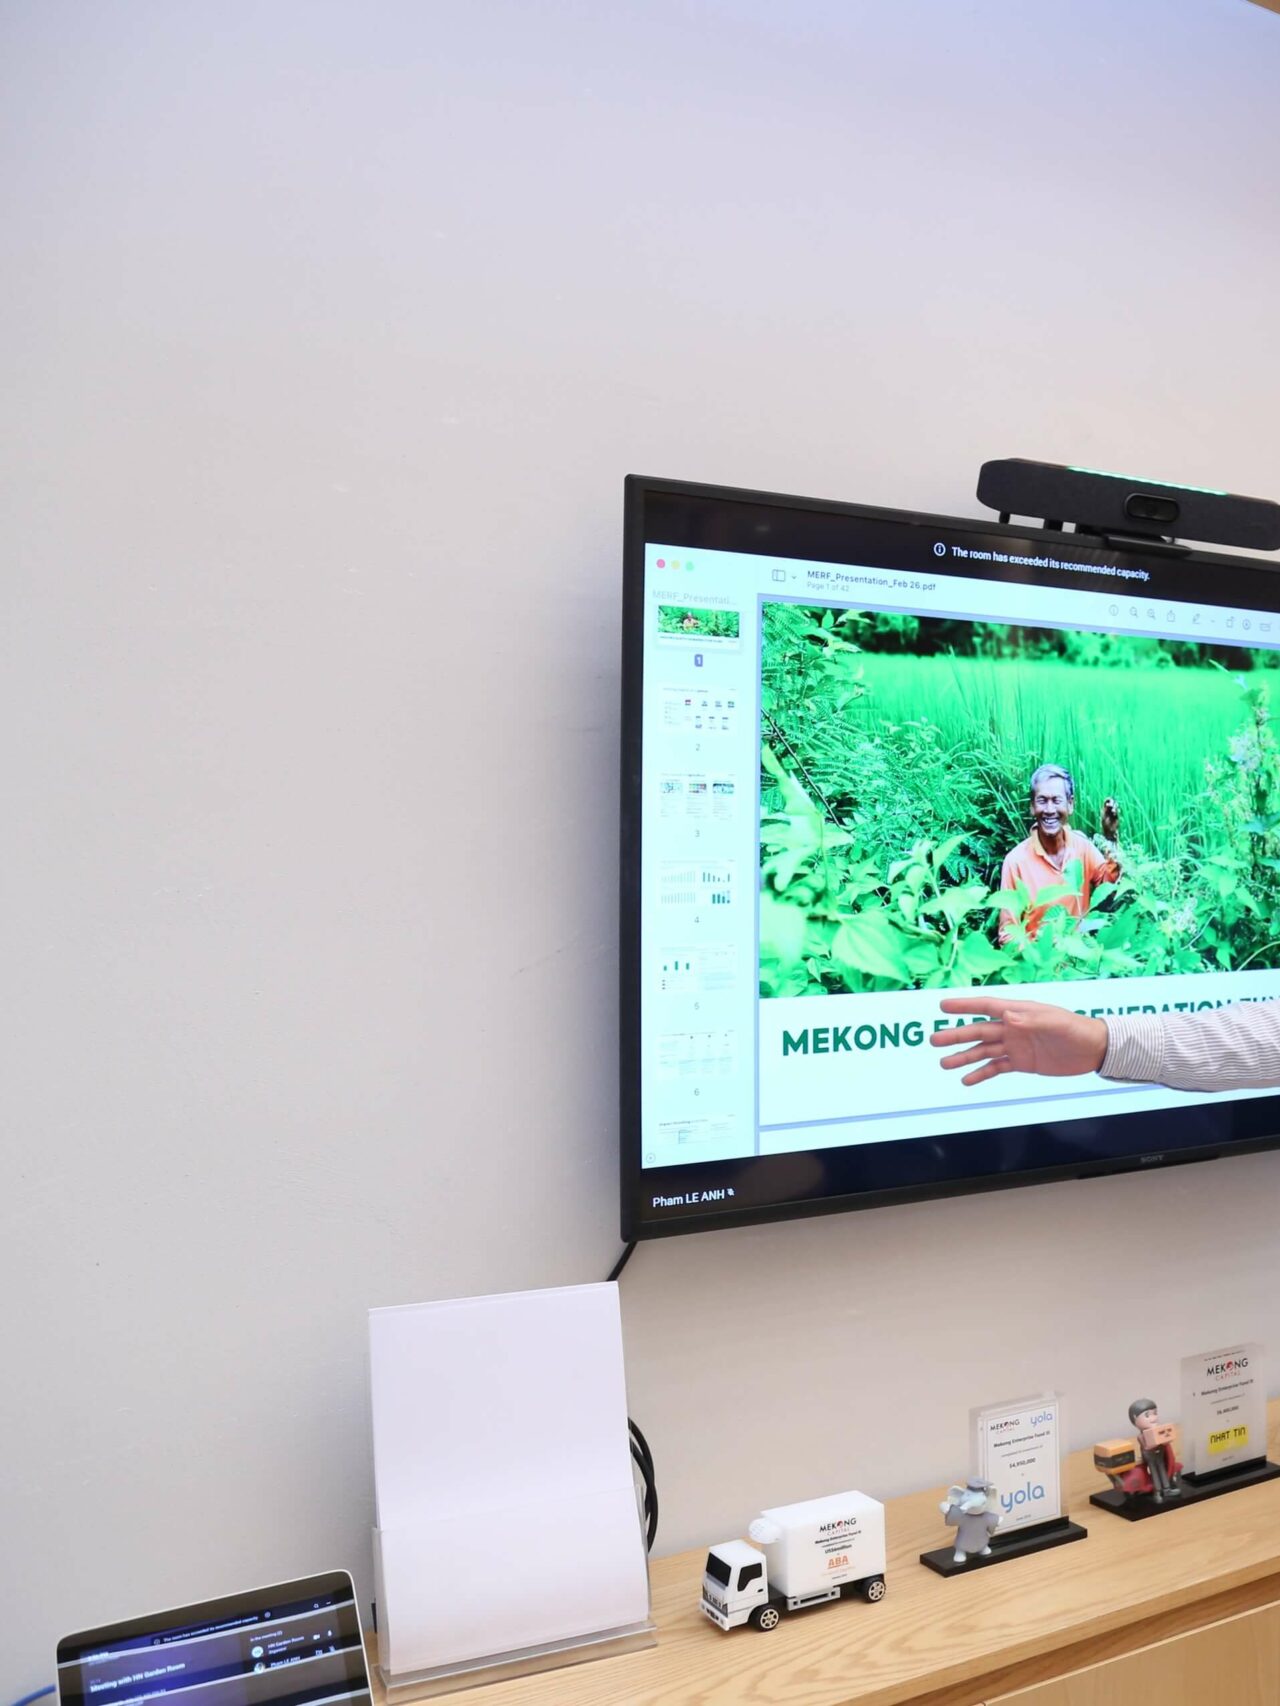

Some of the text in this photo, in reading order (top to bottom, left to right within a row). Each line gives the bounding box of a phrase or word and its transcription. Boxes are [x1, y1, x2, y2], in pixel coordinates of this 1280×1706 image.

[952, 546, 1151, 582] The room has exceeded its recommended capacity.
[807, 570, 936, 591] MERF_Presentation_Feb 26.pdf
[807, 581, 824, 590] Page
[832, 583, 840, 591] of
[782, 1020, 924, 1056] MEKONG
[653, 1188, 725, 1208] Pham LE ANH
[1206, 1357, 1249, 1376] MEKONG
[990, 1419, 1020, 1431] MEKONG
[1030, 1410, 1053, 1428] yola
[1000, 1481, 1045, 1513] yola
[819, 1517, 857, 1532] MEKONG
[828, 1555, 849, 1566] ABA
